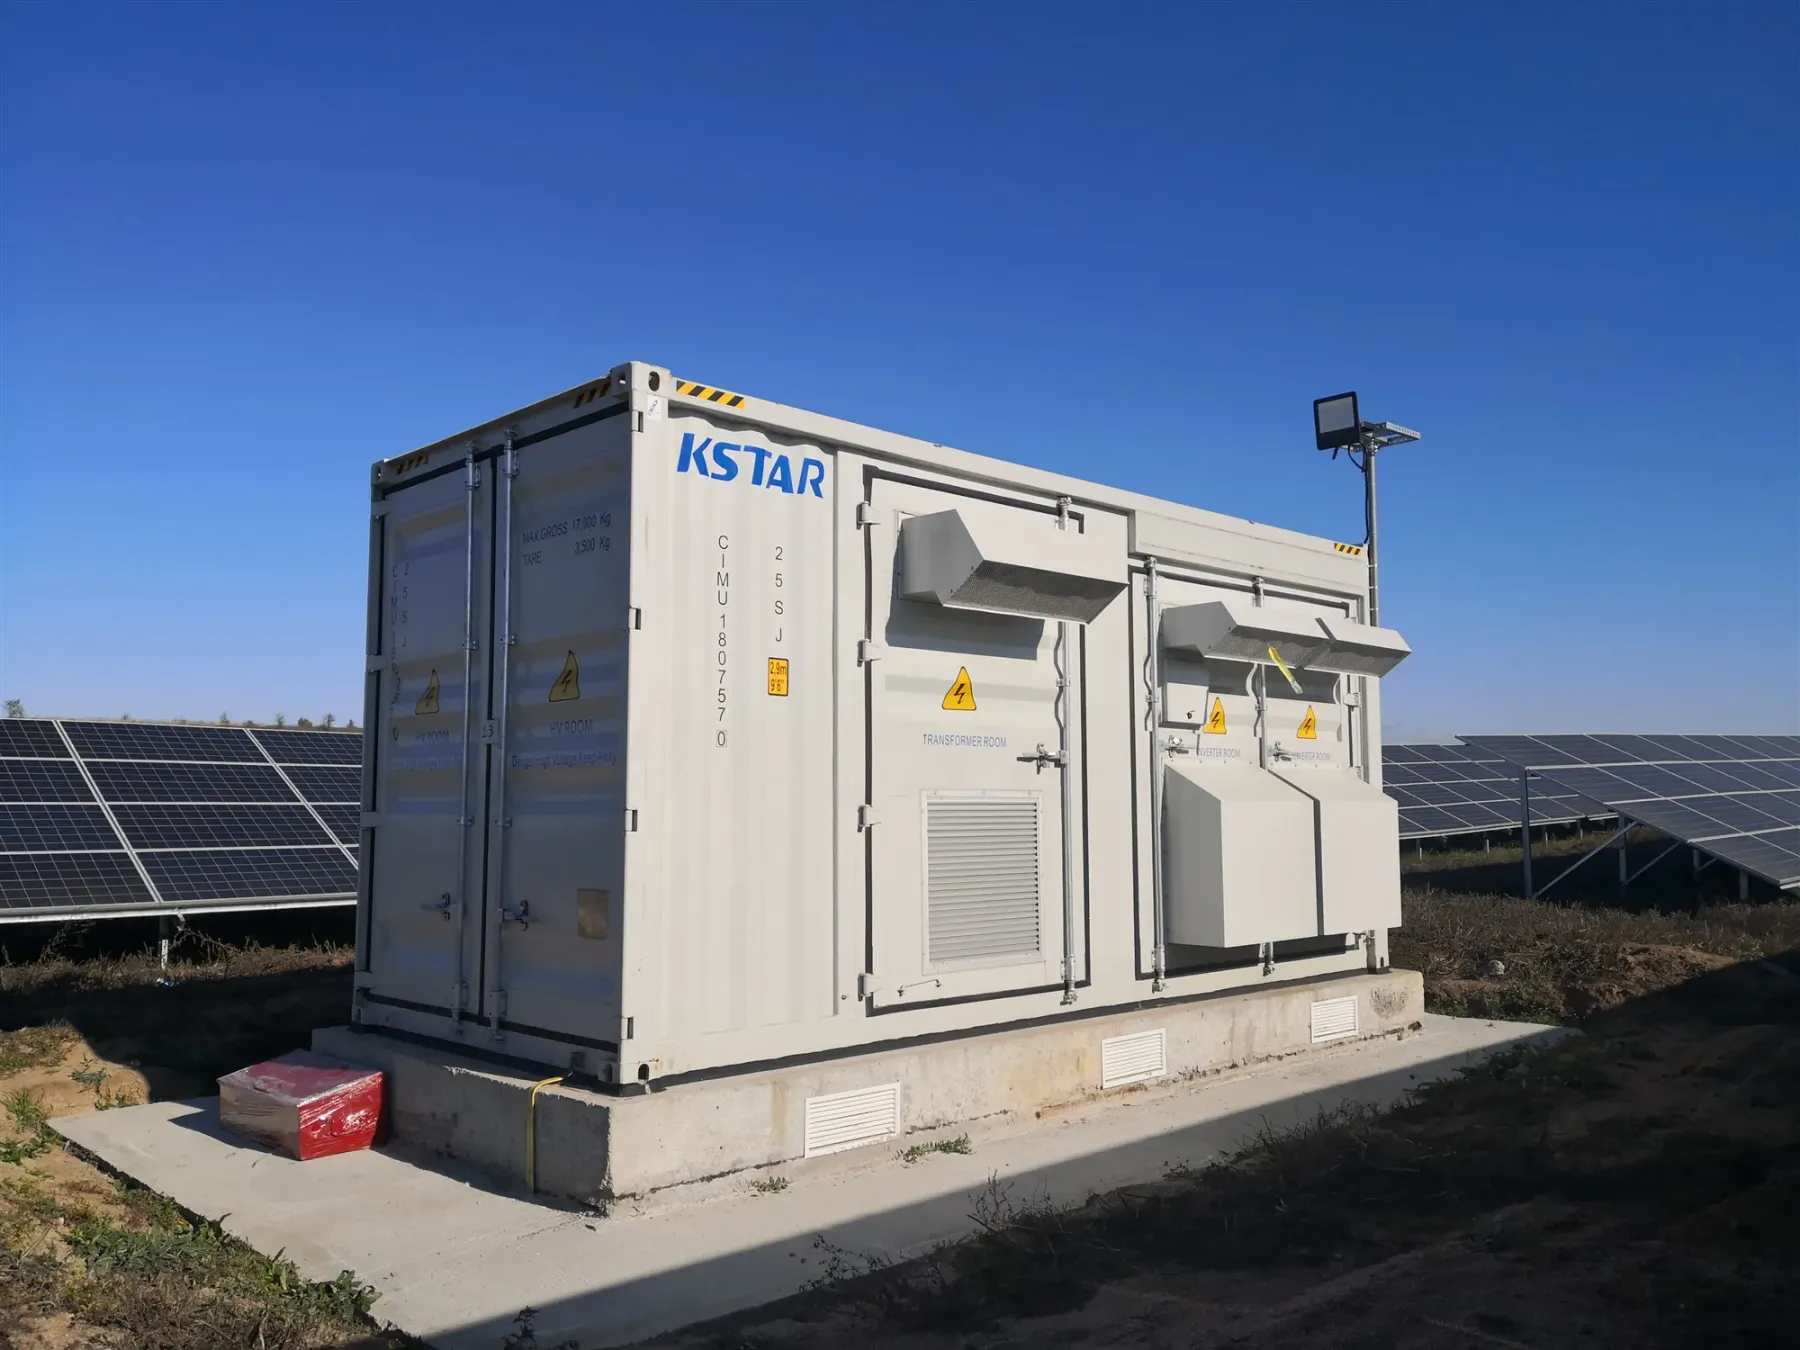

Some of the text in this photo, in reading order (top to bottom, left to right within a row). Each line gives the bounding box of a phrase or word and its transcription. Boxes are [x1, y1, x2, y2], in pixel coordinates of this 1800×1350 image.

[676, 432, 825, 499] KSTAR
[600, 511, 612, 528] Kg
[599, 535, 611, 552] Kg
[549, 718, 594, 735] HV ROOM
[923, 733, 1007, 748] TRANSFORMER ROOM
[1198, 747, 1241, 758] NVERTER ROOM
